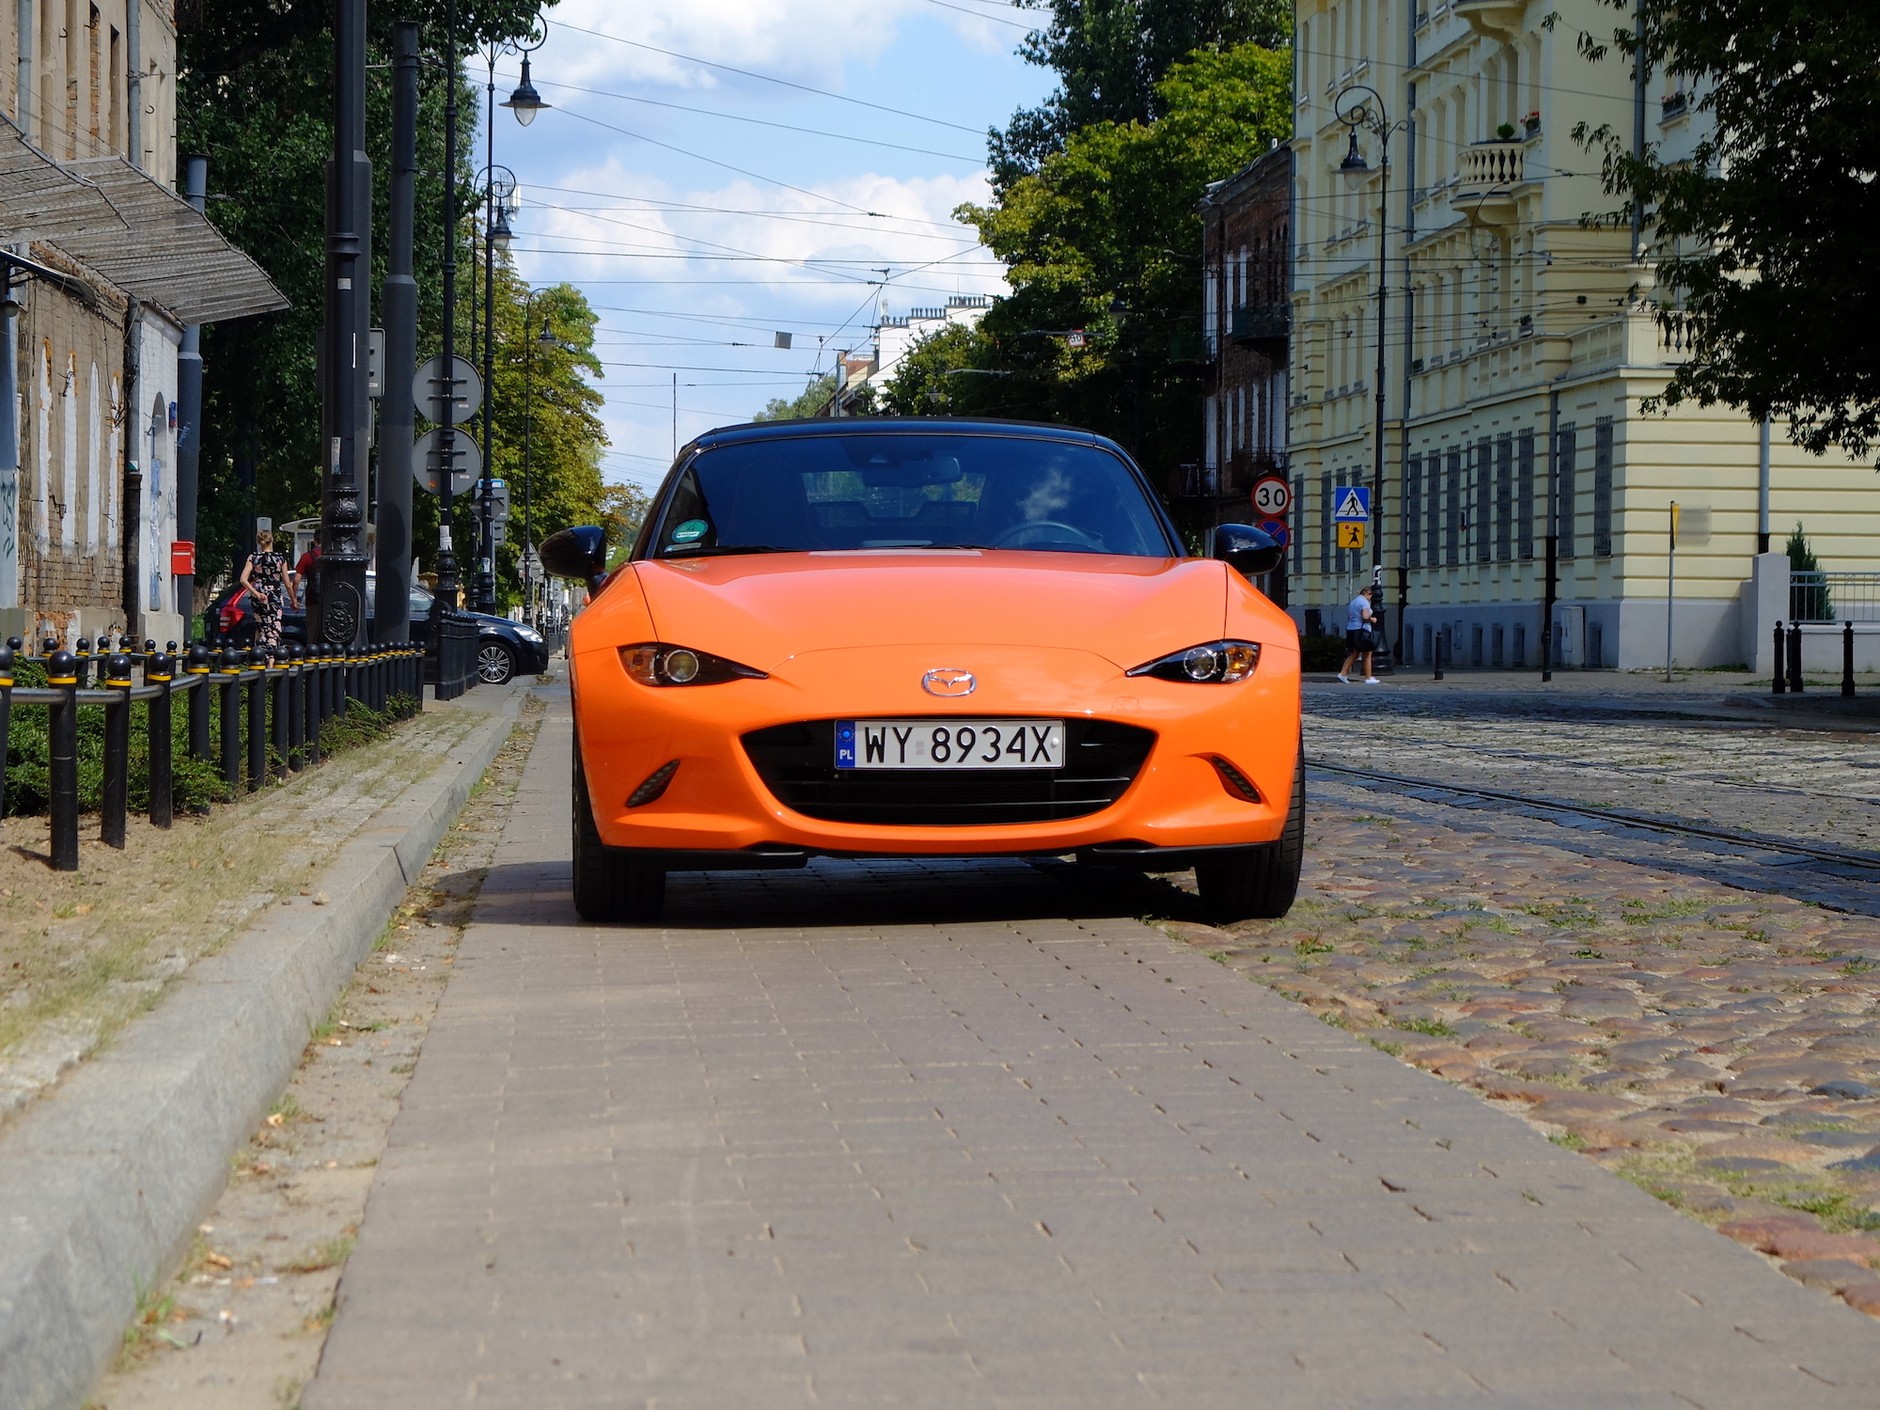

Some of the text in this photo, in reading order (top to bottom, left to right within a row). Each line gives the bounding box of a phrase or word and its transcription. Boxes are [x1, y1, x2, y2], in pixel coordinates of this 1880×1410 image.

[1071, 333, 1082, 342] 30
[1257, 487, 1286, 507] 30
[864, 726, 1052, 763] WY 8934X
[839, 749, 853, 760] PL
